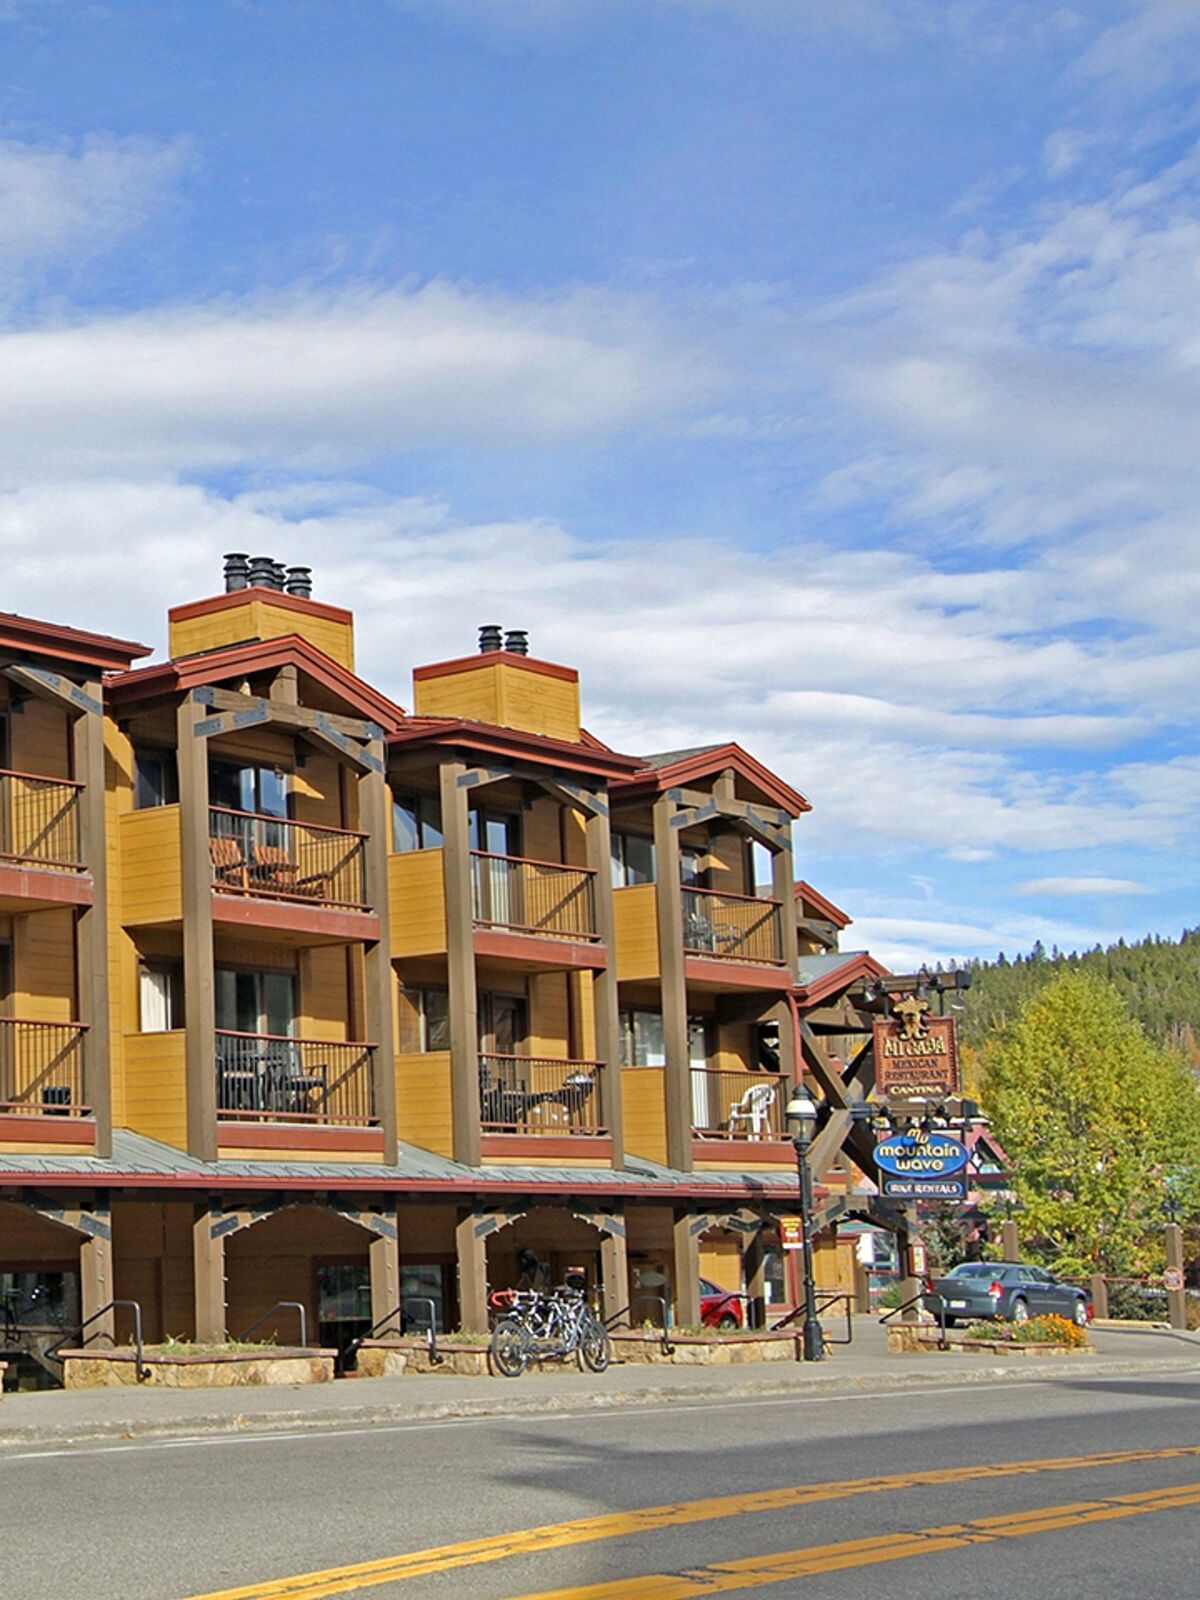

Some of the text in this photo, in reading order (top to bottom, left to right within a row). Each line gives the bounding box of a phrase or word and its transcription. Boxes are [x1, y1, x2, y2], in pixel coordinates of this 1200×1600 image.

[892, 1059, 939, 1069] MEXICAN
[885, 1070, 948, 1081] RESTAURANT
[889, 1086, 942, 1095] CANTINA
[879, 1143, 960, 1157] mountain
[896, 1159, 944, 1171] wave
